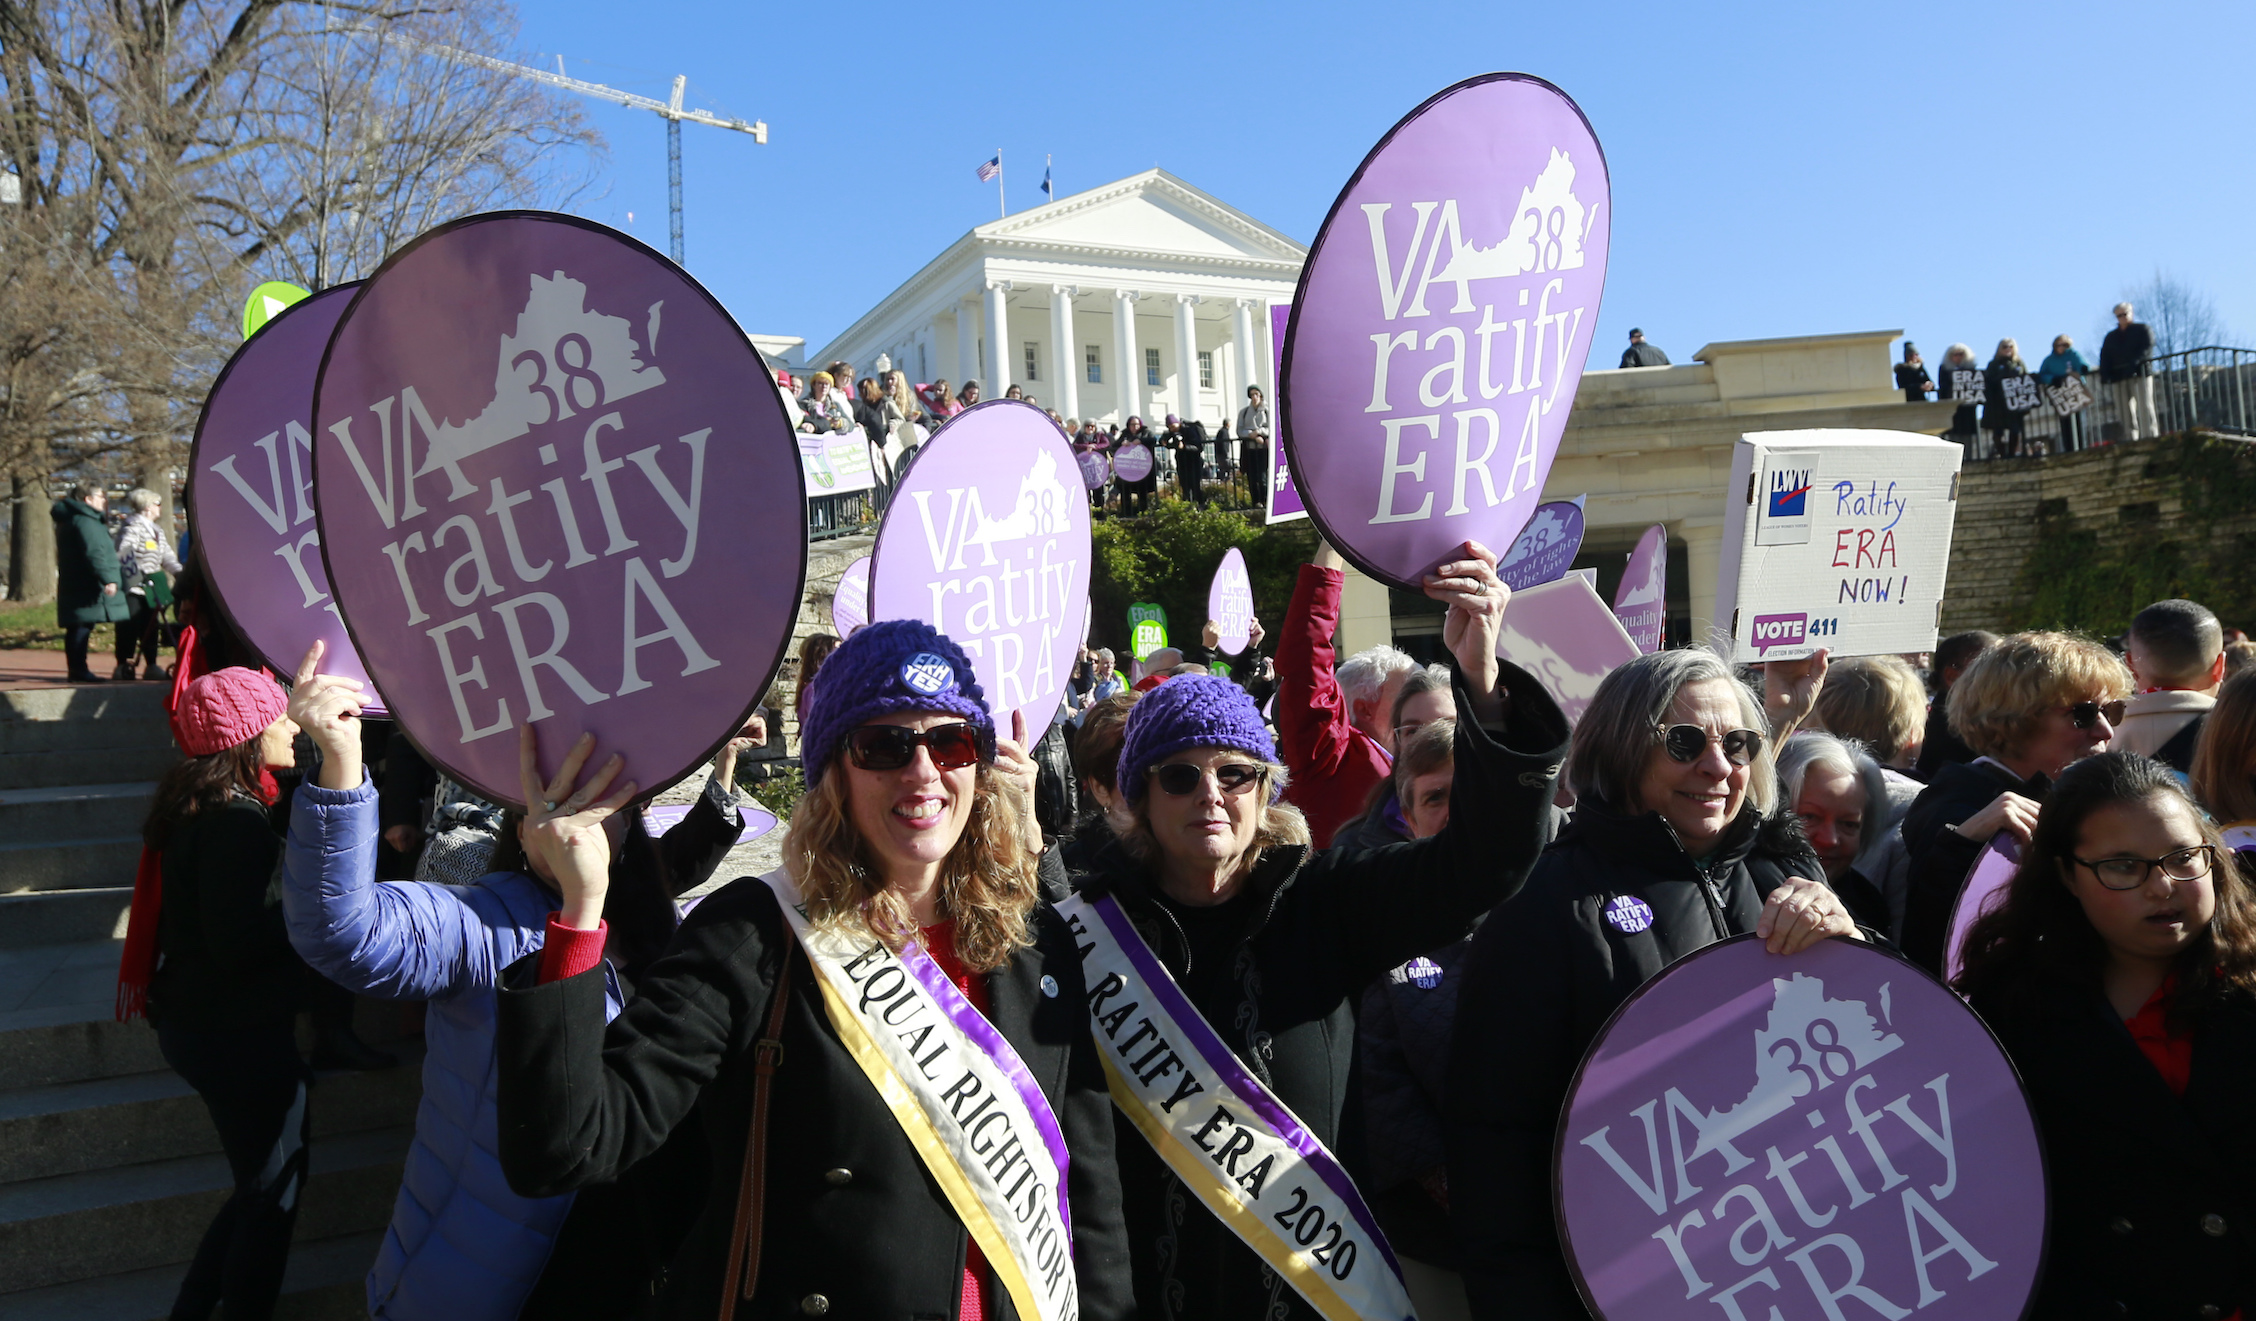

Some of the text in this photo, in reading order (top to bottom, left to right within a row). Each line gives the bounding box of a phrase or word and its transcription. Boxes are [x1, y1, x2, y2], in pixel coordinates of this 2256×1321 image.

[1523, 205, 1563, 272] 38
[1360, 199, 1476, 320] VA
[1365, 278, 1584, 415] ratify
[511, 332, 605, 426] 38
[1952, 370, 1985, 382] ERA
[1952, 382, 1965, 390] IN
[2001, 374, 2036, 390] ERA
[2006, 394, 2041, 411] USA
[2056, 393, 2091, 416] USA
[329, 386, 478, 528] VA
[1368, 395, 1540, 524] ERA
[1772, 469, 1809, 493] LWV
[382, 411, 713, 626] ratify
[1024, 488, 1054, 536] 38
[1832, 480, 1907, 532] Ratify
[911, 486, 999, 573] VA
[1520, 527, 1549, 560] 38
[1523, 535, 1579, 573] of rights
[1832, 528, 1898, 569] ERA
[927, 538, 1077, 638] ratify
[1220, 568, 1235, 594] VA
[1517, 571, 1540, 589] the
[1542, 554, 1566, 576] law
[839, 581, 866, 606] Equality
[1219, 590, 1251, 621] ratify
[1137, 625, 1162, 643] ERA
[1221, 612, 1247, 638] ERA
[1630, 630, 1656, 646] nder
[1755, 618, 1838, 641] VOTE 411
[426, 556, 721, 743] ERA
[904, 664, 943, 693] YES
[1605, 903, 1650, 923] RATIFY
[1612, 895, 1635, 908] VA
[1620, 917, 1648, 933] ERA
[1408, 966, 1442, 978] RATIFY
[1416, 956, 1431, 967] VA
[1416, 977, 1437, 989] ERA
[841, 940, 951, 1081] EQUAL
[1767, 1018, 1856, 1100] 38
[1087, 971, 1204, 1114] RATIFY
[1190, 1104, 1275, 1200] ERA
[1273, 1186, 1357, 1281] 2020
[1579, 1086, 1755, 1217] VA
[1652, 1073, 1957, 1300] ratify
